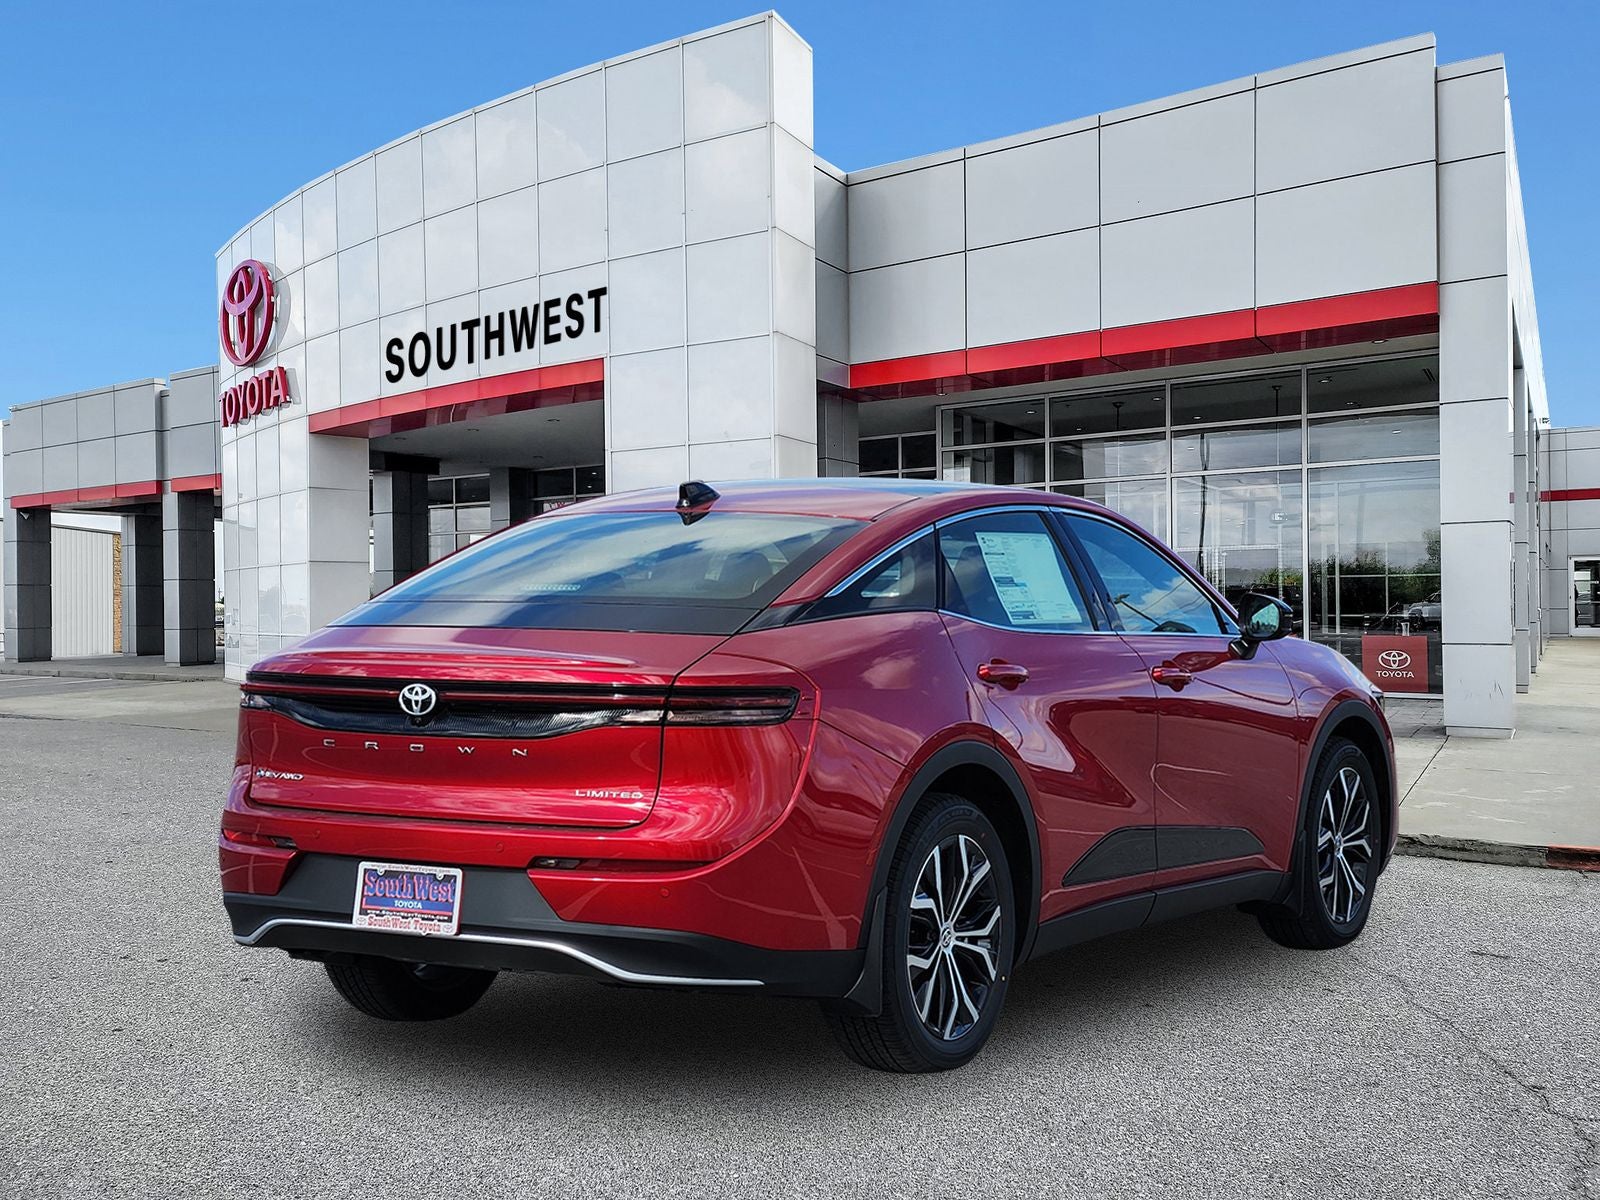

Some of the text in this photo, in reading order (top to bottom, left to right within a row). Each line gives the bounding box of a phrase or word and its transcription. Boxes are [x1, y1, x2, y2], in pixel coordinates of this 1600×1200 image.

[385, 286, 608, 384] SOUTHWEST
[217, 366, 291, 428] TOYOTA
[1376, 670, 1415, 678] TOYOTA
[323, 738, 528, 757] CROWN
[575, 789, 644, 799] LIMITED
[394, 900, 422, 909] TOYOTA
[414, 919, 441, 933] Toyota
